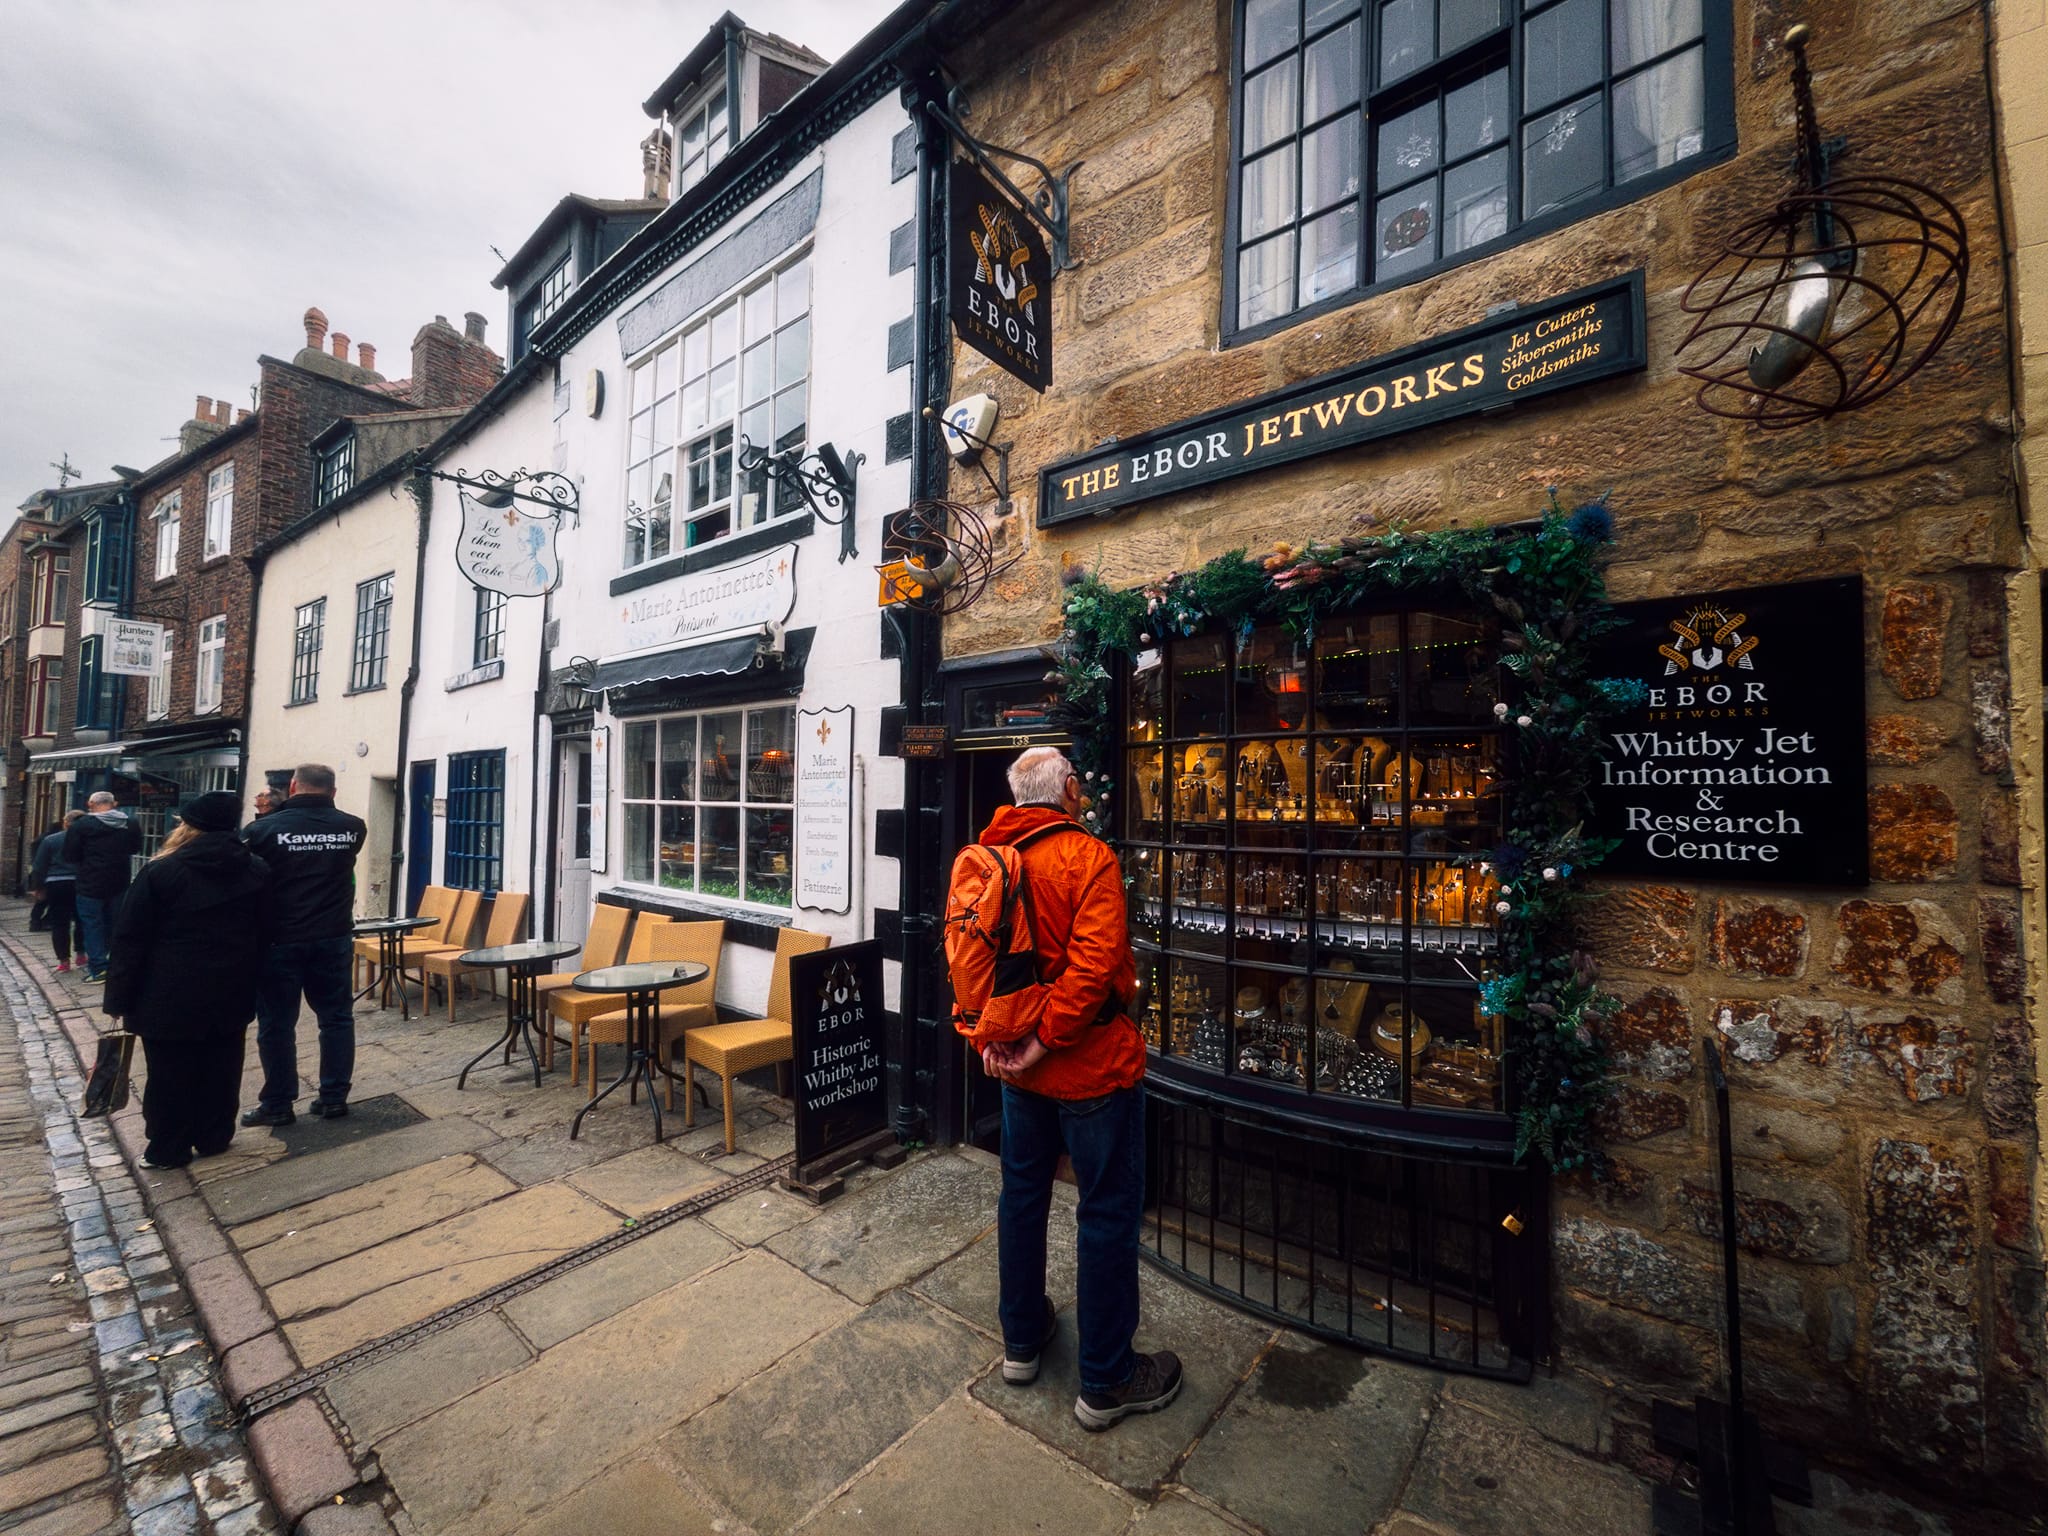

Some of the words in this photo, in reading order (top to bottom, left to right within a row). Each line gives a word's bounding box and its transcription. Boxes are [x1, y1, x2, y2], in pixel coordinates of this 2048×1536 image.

[967, 285, 1039, 360] EBOR
[1508, 334, 1530, 353] Jet
[1535, 302, 1596, 339] Cutters
[967, 317, 1040, 374] JETWORKS
[1501, 318, 1603, 374] Silversmiths
[1507, 341, 1601, 392] Goldsmiths
[1062, 463, 1120, 501] THE
[1130, 431, 1231, 484] EBOR
[1243, 353, 1486, 457] JETWORKS
[480, 519, 501, 537] Let
[470, 549, 494, 560] eat
[471, 535, 501, 549] them
[471, 561, 505, 577] Cake
[631, 595, 673, 624] Marie
[676, 559, 775, 612] Antoinette's
[114, 624, 155, 637] Hunters
[672, 611, 720, 637] Patisserie
[136, 637, 153, 646] Shop
[1691, 675, 1720, 683] THE
[1649, 682, 1769, 708] EBOR
[1648, 707, 1769, 721] JETWORKS
[1611, 731, 1744, 760] Whitby
[1754, 728, 1816, 755] Jet
[800, 767, 847, 780] Antoinette's
[812, 754, 838, 767] Marie
[1601, 759, 1832, 786] Information
[1696, 788, 1725, 811] &
[1625, 807, 1804, 834] Research
[277, 831, 358, 845] Kawasaki
[288, 844, 323, 852] Racing
[1646, 832, 1779, 862] Centre
[803, 878, 843, 895] Patisserie
[818, 1007, 865, 1033] EBOR
[812, 1035, 871, 1068] Historic
[804, 1062, 857, 1092] Whitby
[859, 1053, 880, 1072] Jet
[807, 1075, 878, 1112] workshop
